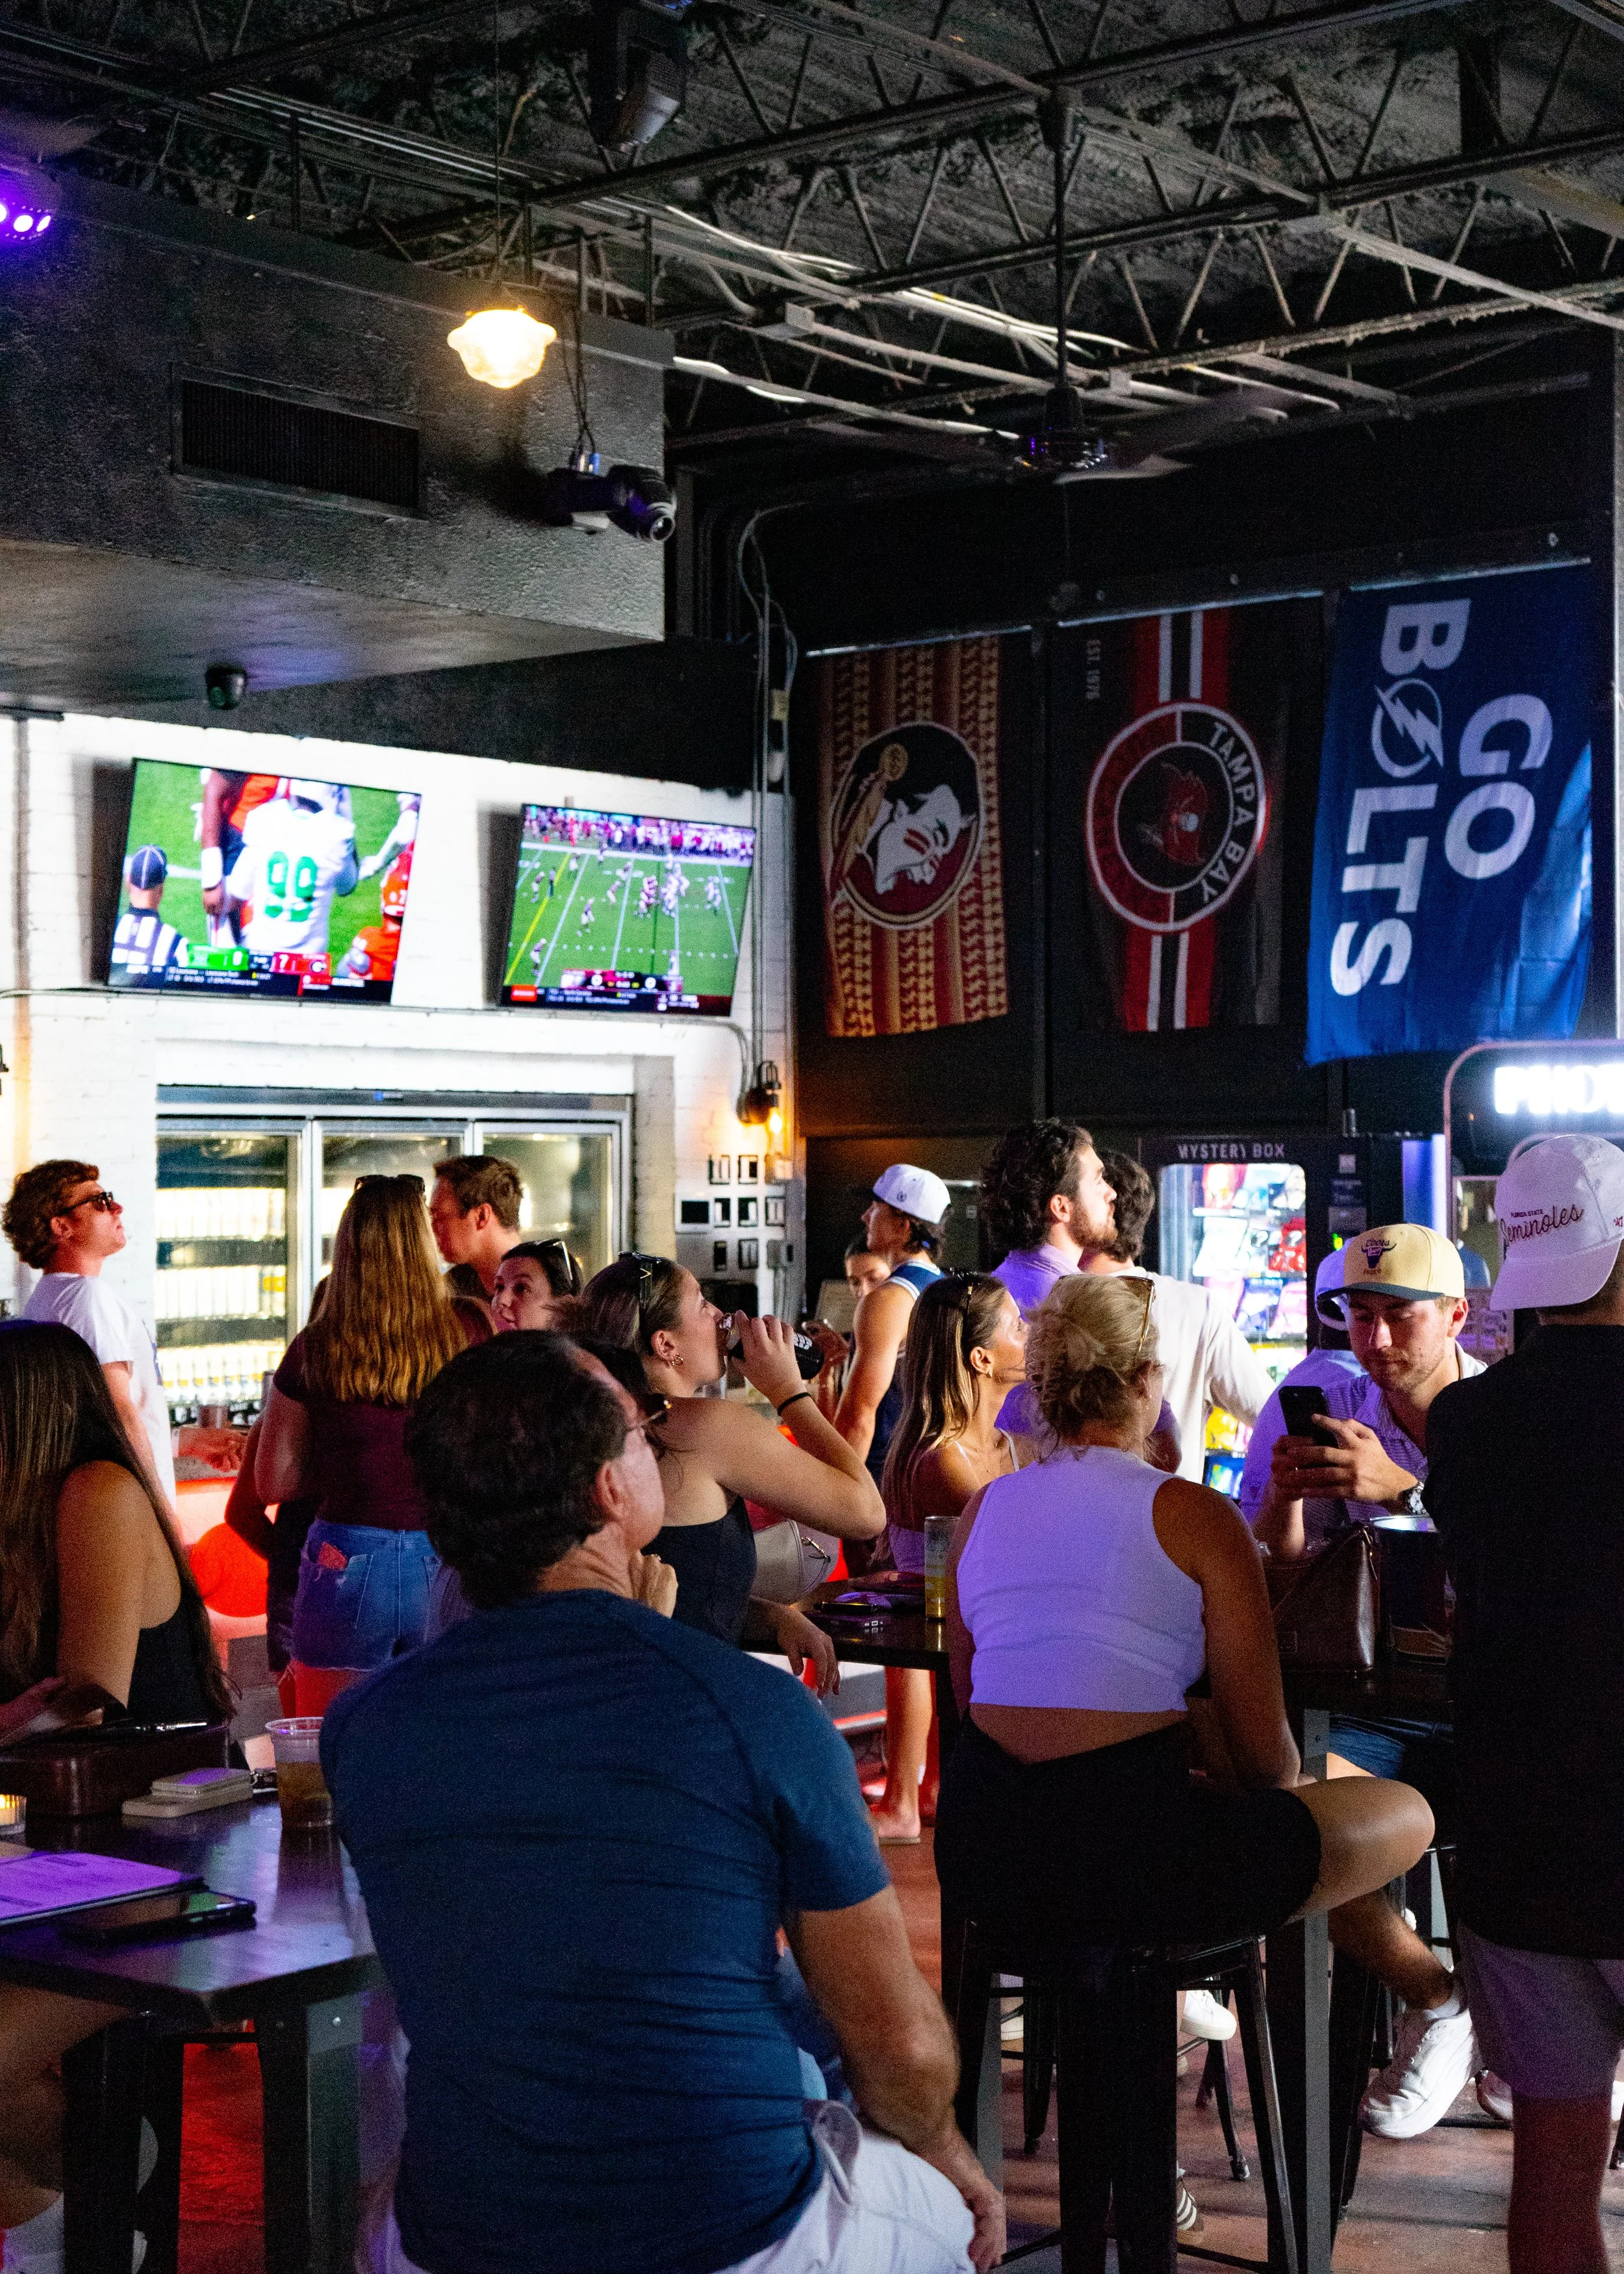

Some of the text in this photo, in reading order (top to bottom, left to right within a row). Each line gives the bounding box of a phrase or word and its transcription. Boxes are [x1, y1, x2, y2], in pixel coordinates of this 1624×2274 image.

[1199, 721, 1255, 903] TAMPA BAY
[1444, 693, 1553, 880] GO
[1252, 1142, 1284, 1158] BOX
